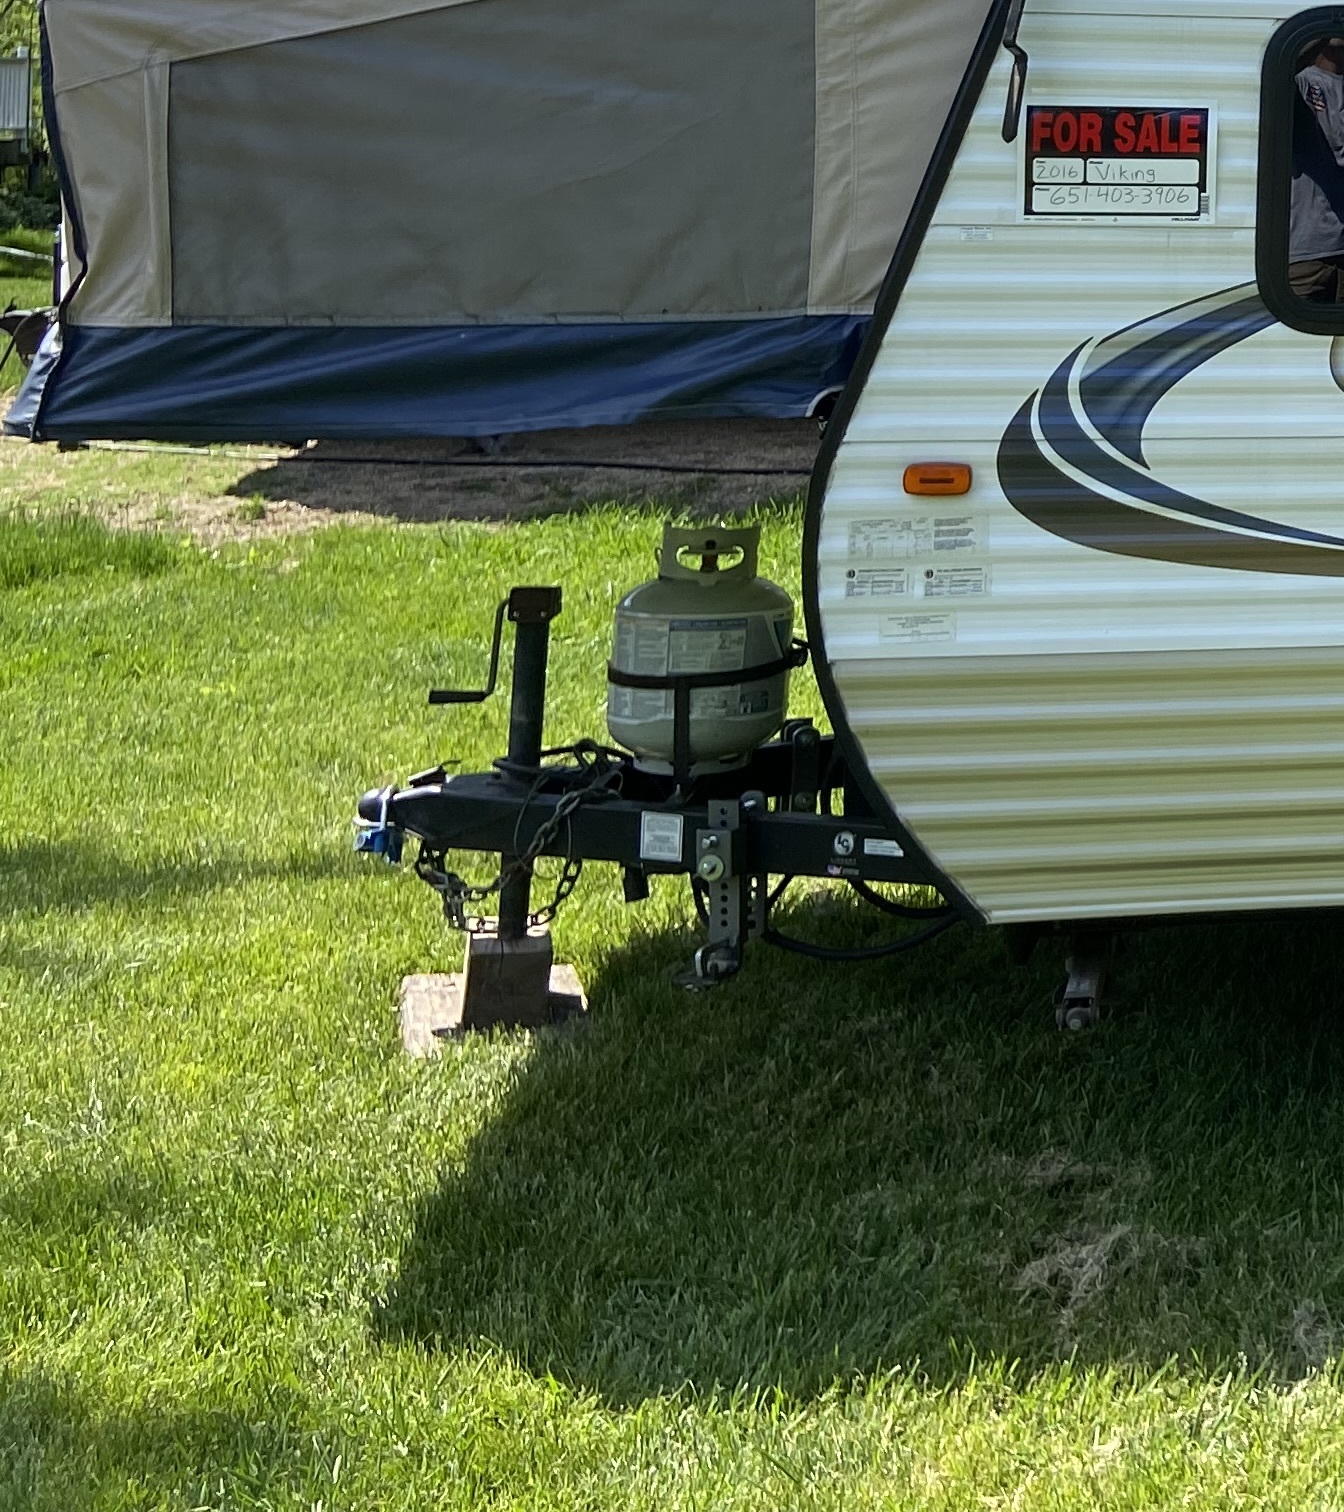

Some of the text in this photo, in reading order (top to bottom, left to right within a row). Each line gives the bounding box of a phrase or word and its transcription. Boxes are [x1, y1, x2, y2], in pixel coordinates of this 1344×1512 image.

[1032, 111, 1201, 153] FOR SALE
[1036, 164, 1078, 179] 2016
[1095, 163, 1156, 182] Viking
[1050, 186, 1190, 205] 651-403-3906
